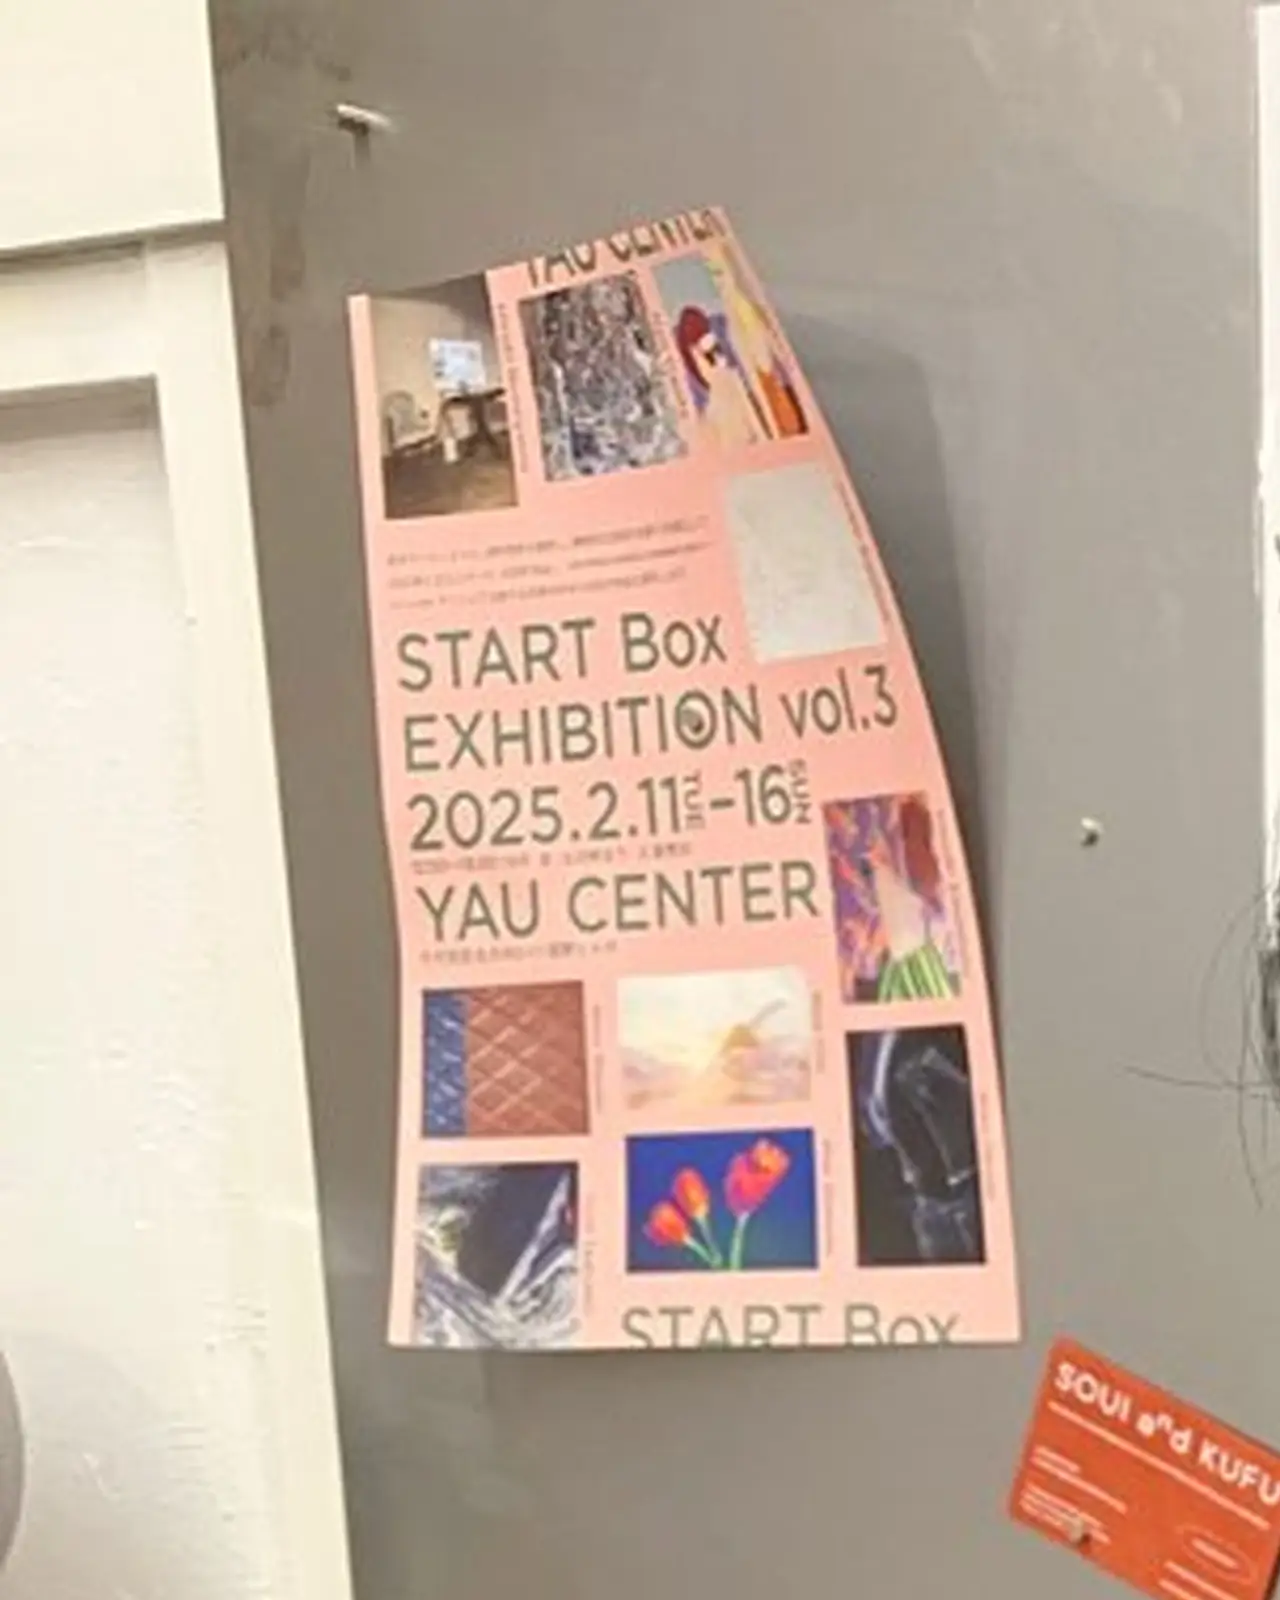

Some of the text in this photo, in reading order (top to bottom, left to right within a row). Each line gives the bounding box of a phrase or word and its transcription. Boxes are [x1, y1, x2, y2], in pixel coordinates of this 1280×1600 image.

[397, 611, 728, 692] START Box
[403, 664, 898, 772] EXHIBITION vol.3
[415, 879, 540, 942] YAU
[567, 859, 822, 934] CENTER
